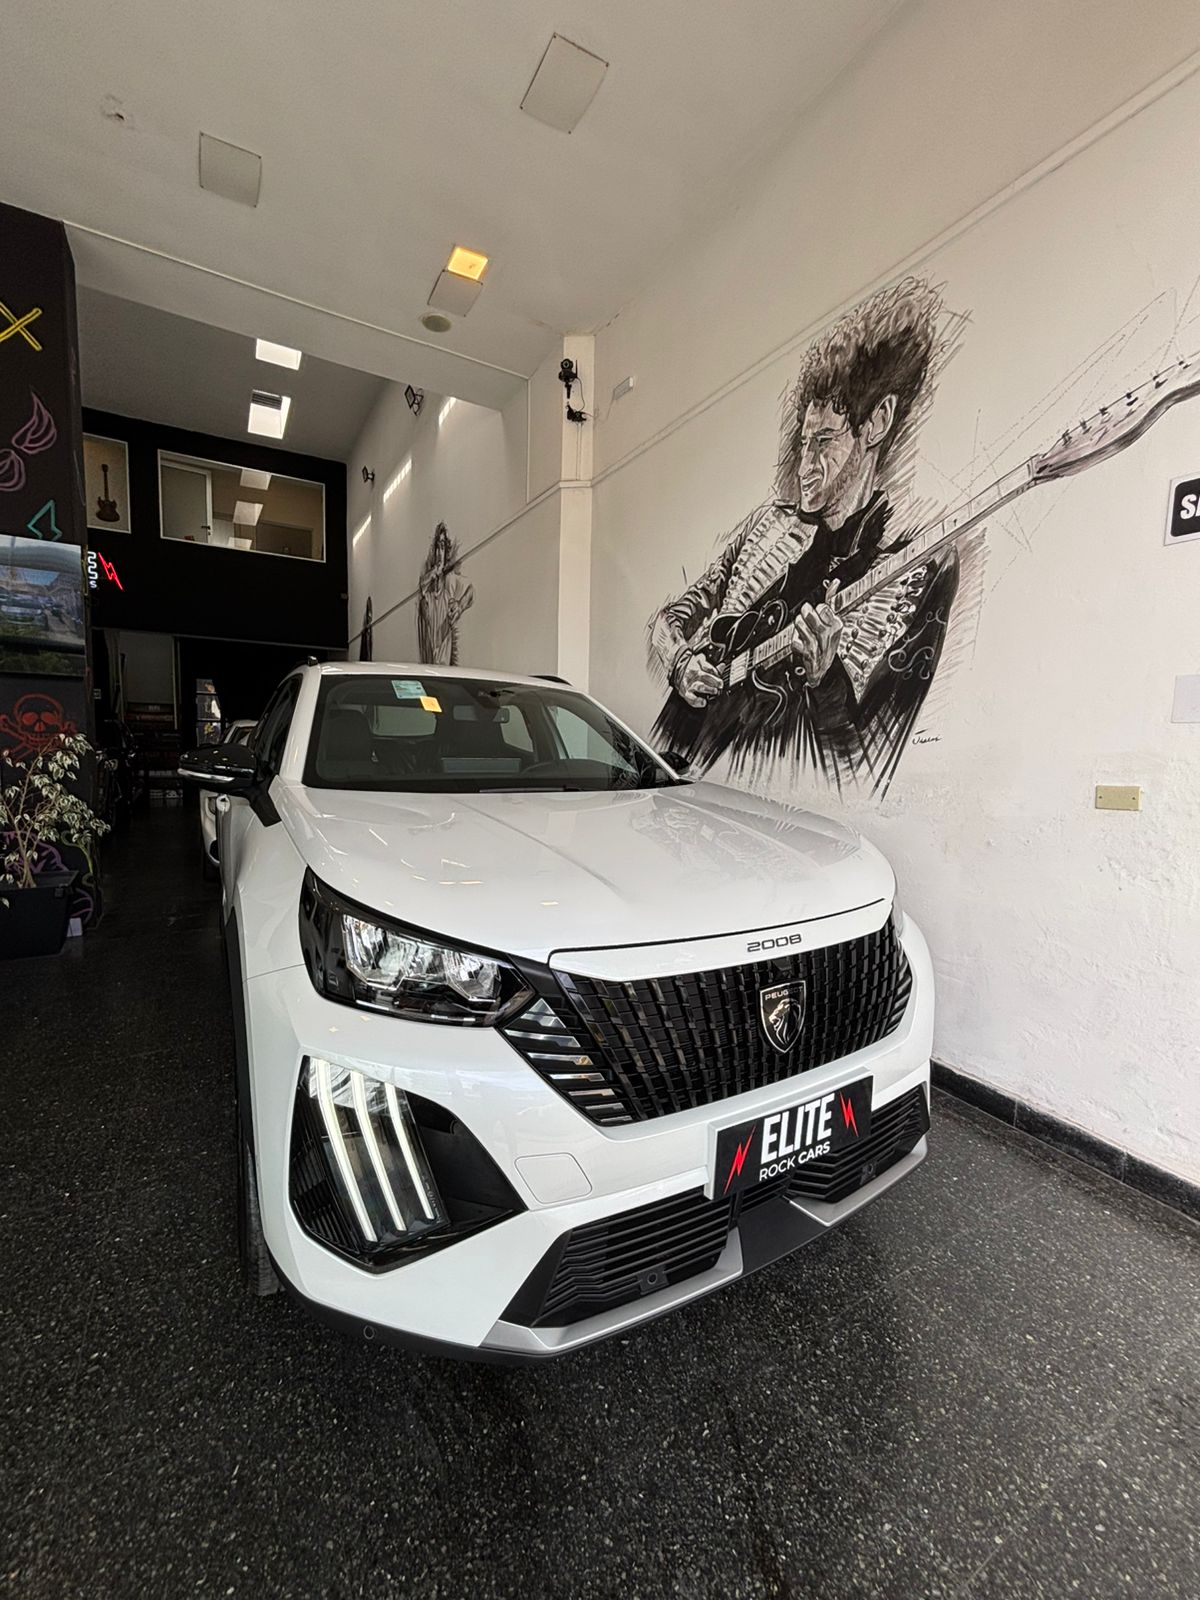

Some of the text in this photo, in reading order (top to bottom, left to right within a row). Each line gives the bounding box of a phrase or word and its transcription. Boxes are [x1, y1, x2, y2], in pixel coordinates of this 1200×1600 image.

[1180, 494, 1200, 519] S
[747, 934, 802, 952] 2008
[761, 1092, 835, 1165] ELITE
[759, 1141, 831, 1181] ROCK CARS
